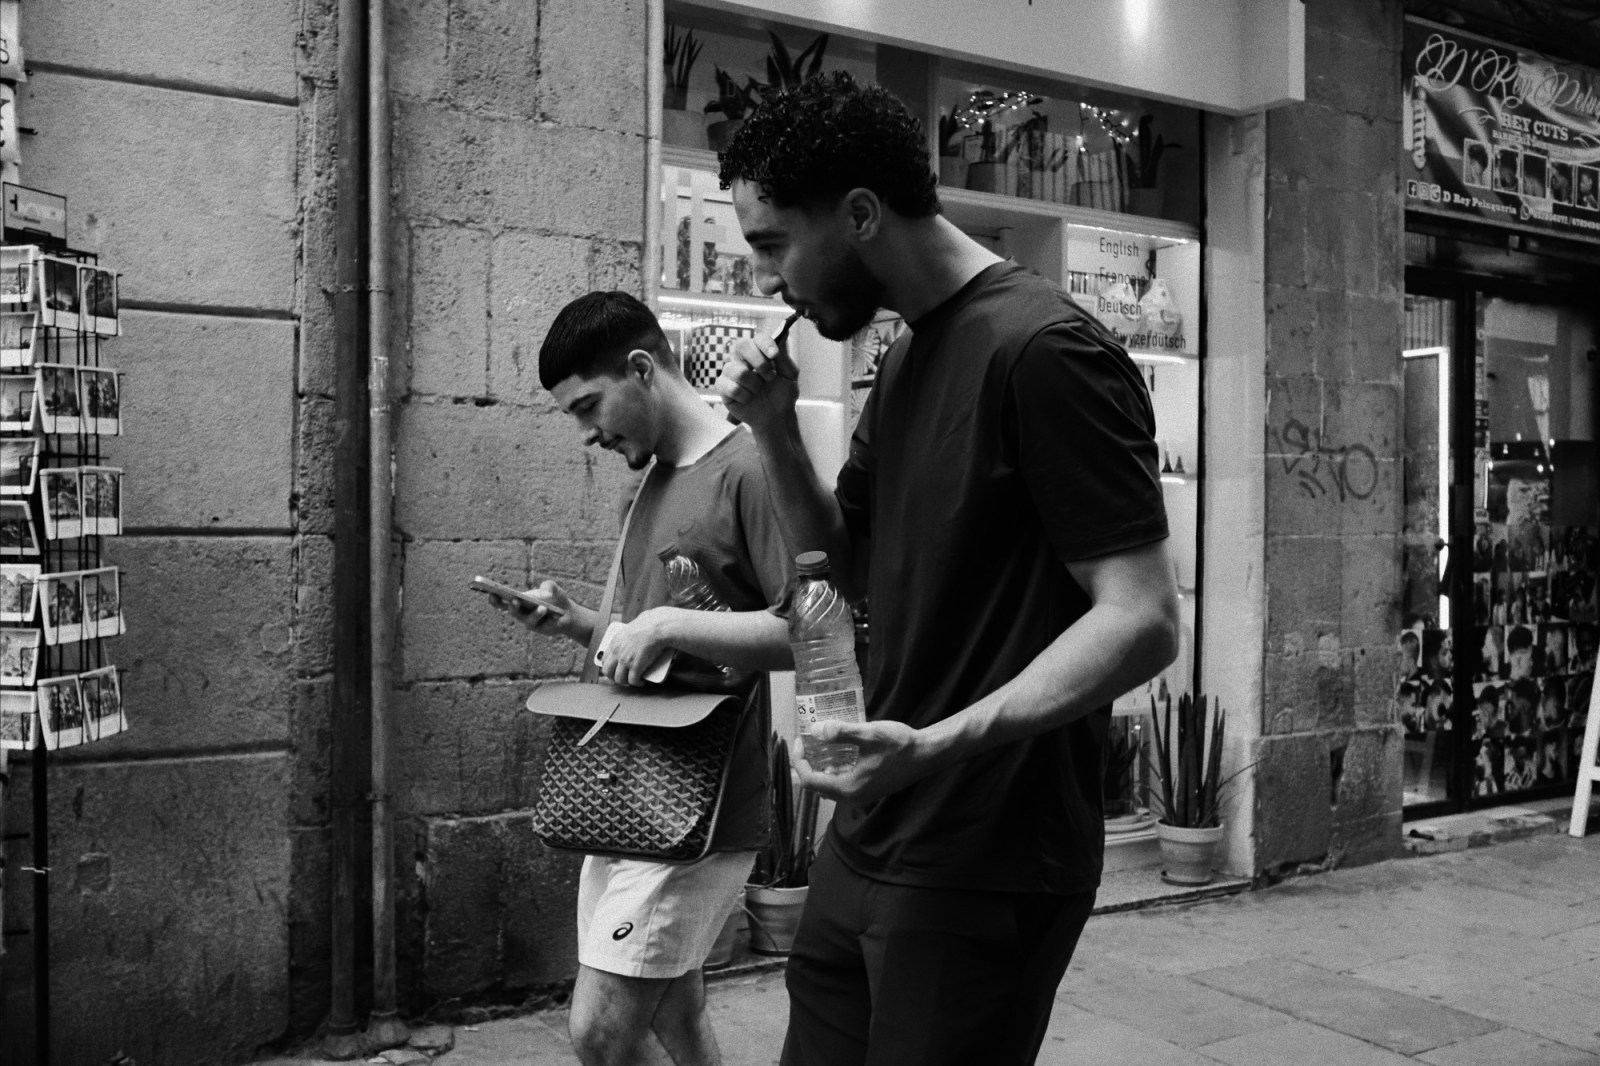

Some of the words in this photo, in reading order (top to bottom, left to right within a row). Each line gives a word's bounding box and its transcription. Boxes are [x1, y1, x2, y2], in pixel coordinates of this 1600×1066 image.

[1533, 121, 1568, 141] CUTS
[1443, 190, 1451, 201] D
[1453, 193, 1470, 206] Rey
[1100, 237, 1139, 258] English
[1100, 296, 1142, 315] Deutsch
